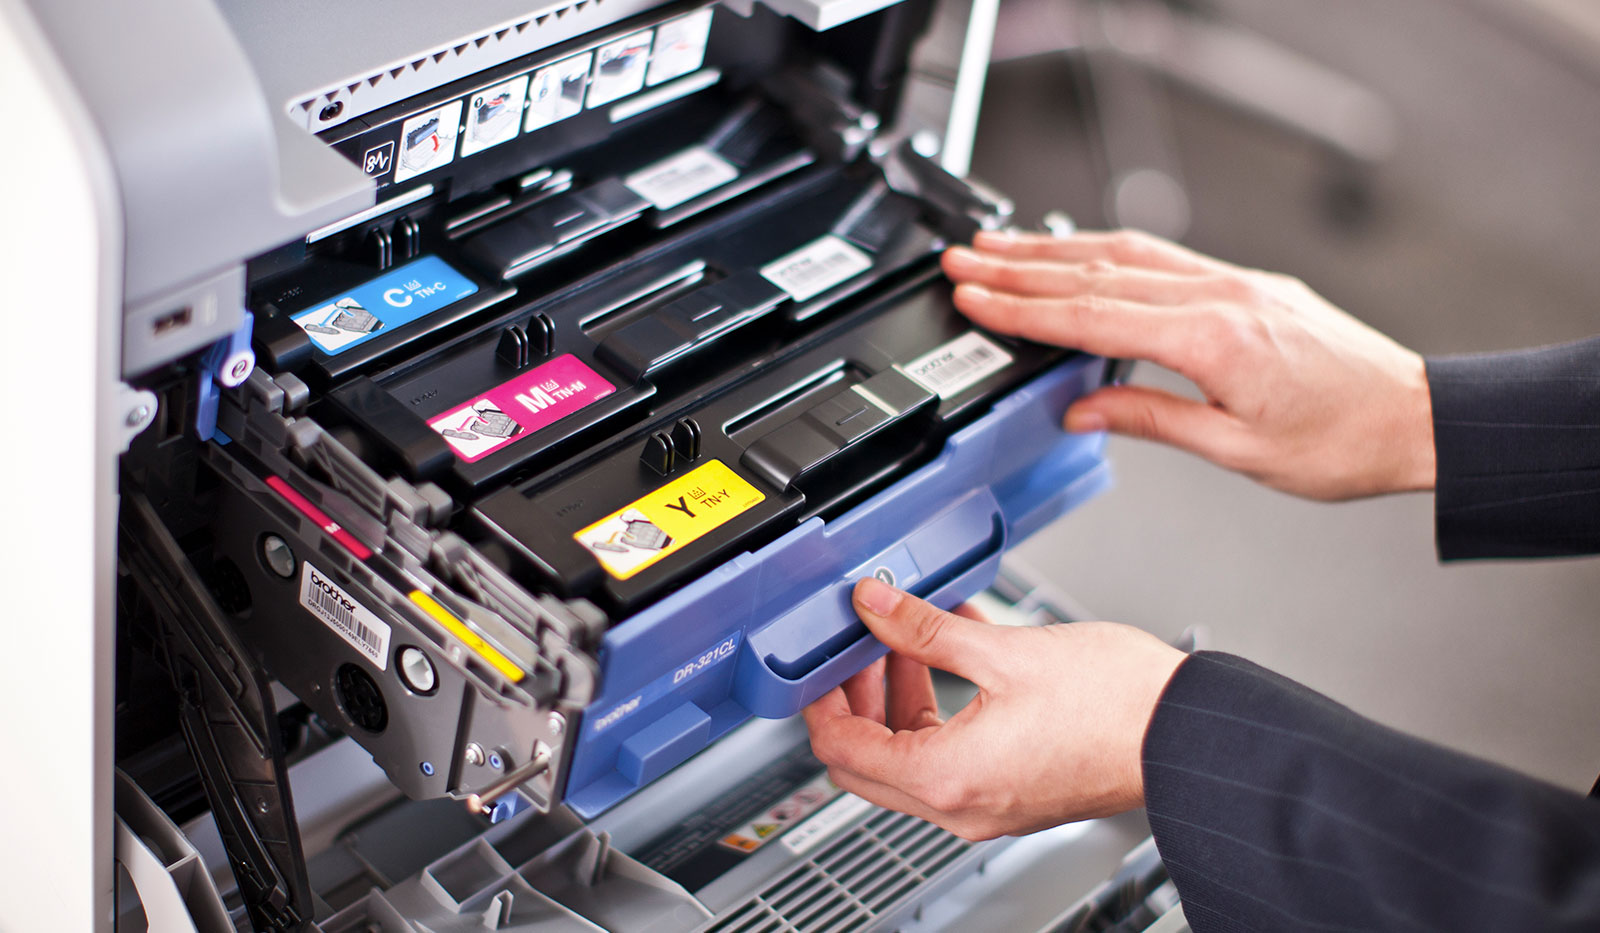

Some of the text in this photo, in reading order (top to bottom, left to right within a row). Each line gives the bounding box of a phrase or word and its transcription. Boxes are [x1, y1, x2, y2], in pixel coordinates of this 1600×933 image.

[383, 288, 413, 308] C
[414, 282, 446, 299] TN-C
[514, 386, 557, 414] M
[552, 380, 587, 400] TN-M
[664, 496, 696, 518] Y
[700, 488, 730, 508] TN-Y
[325, 522, 341, 534] M
[311, 570, 356, 613] brother
[673, 639, 735, 684] DR-321CL
